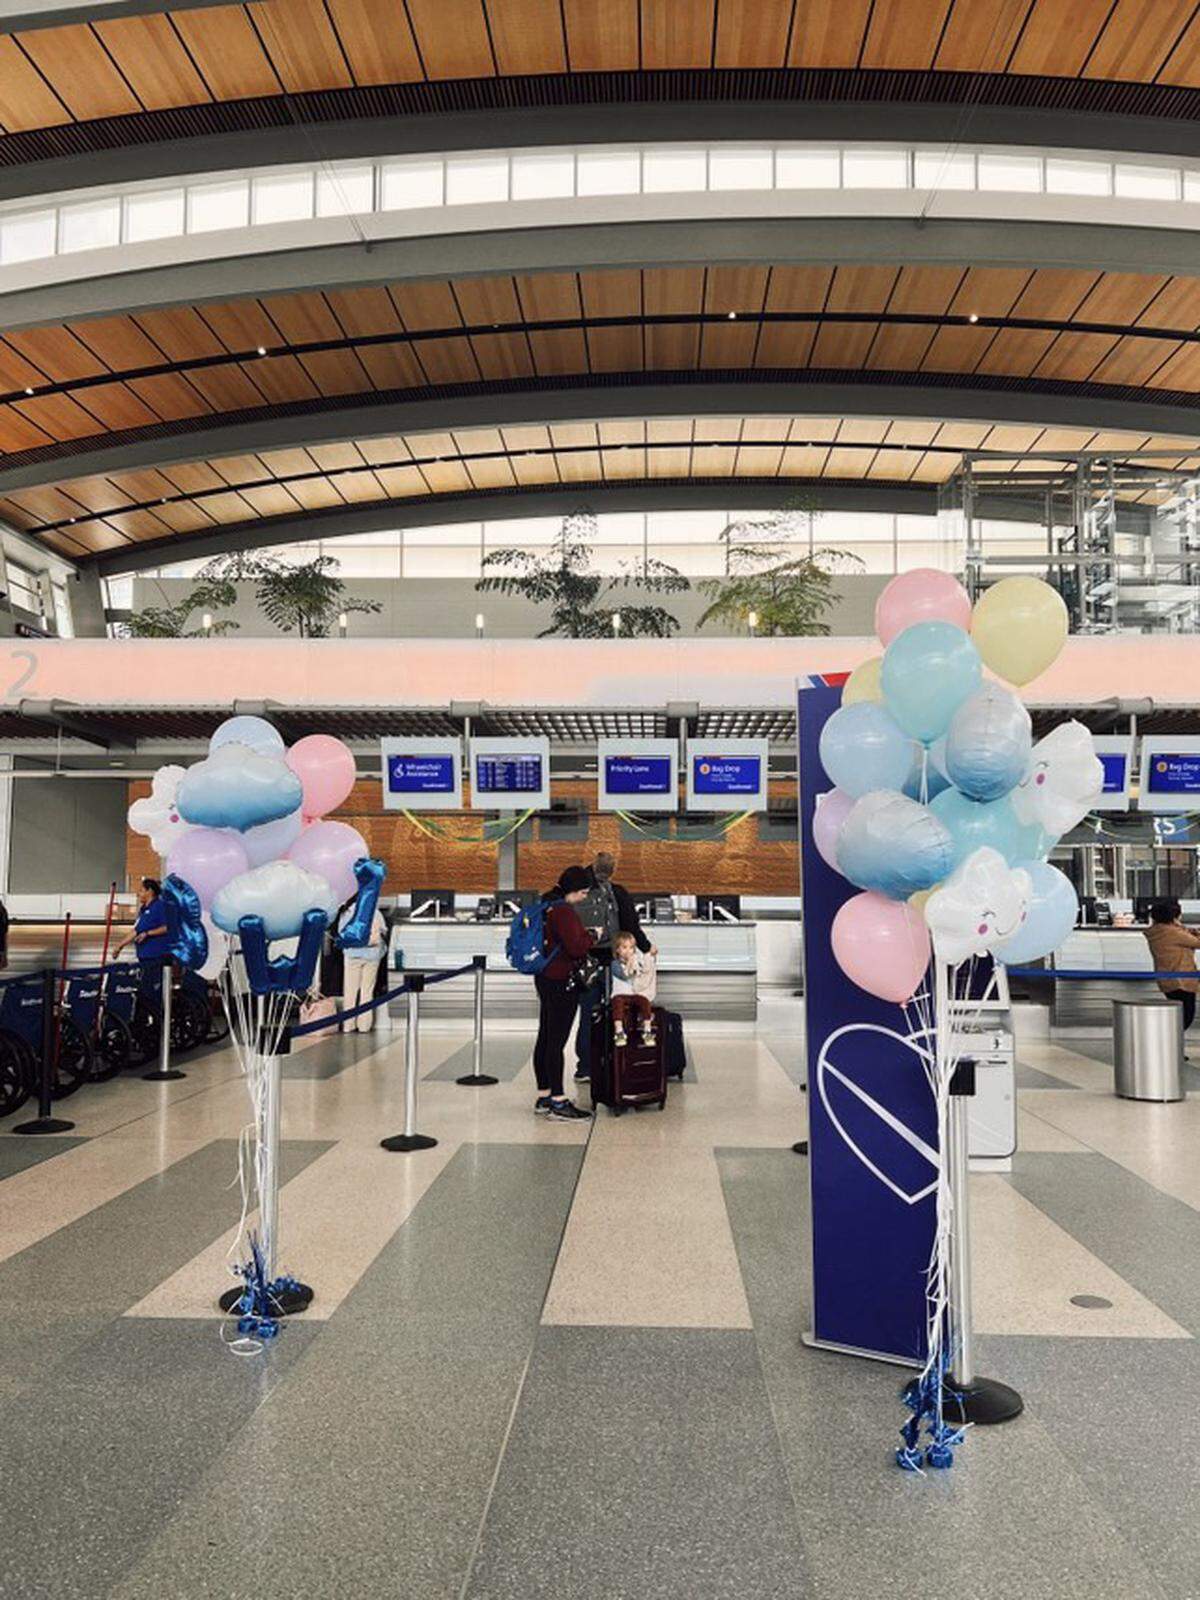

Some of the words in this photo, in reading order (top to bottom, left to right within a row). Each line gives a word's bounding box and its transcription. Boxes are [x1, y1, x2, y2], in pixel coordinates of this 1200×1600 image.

[5, 649, 39, 698] 2
[611, 765, 632, 773] Priority
[712, 765, 724, 773] Bag
[725, 765, 740, 773] Drop
[1170, 763, 1182, 772] Bag
